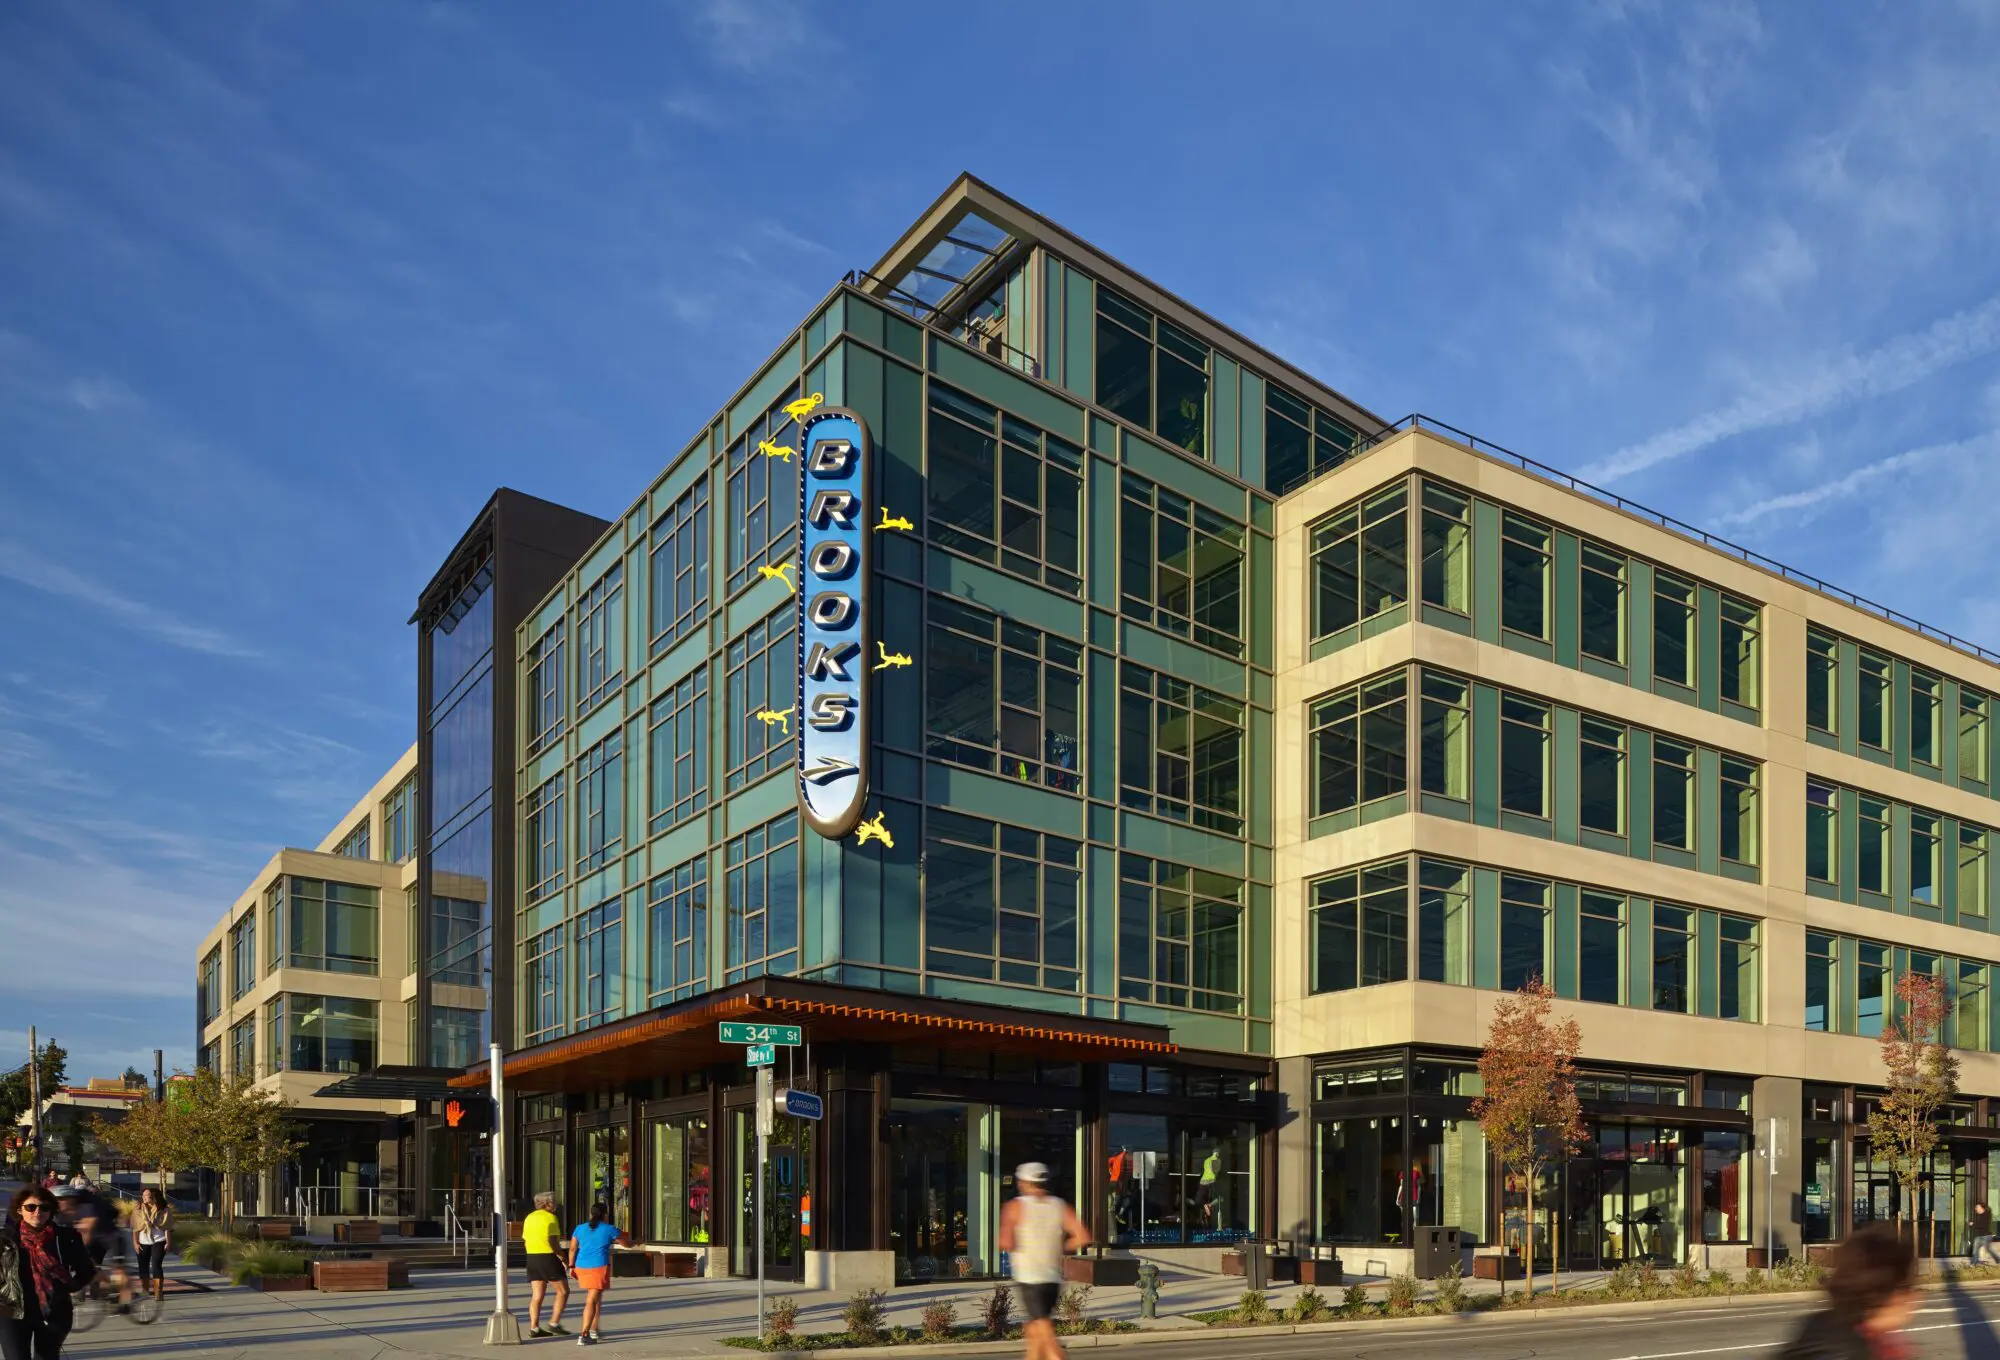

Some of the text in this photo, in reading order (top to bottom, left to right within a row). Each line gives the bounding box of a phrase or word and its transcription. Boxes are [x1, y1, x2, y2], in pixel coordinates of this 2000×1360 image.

[806, 438, 860, 732] BROOKS
[723, 1026, 798, 1042] N 34th St
[795, 1100, 819, 1112] BROOKS
